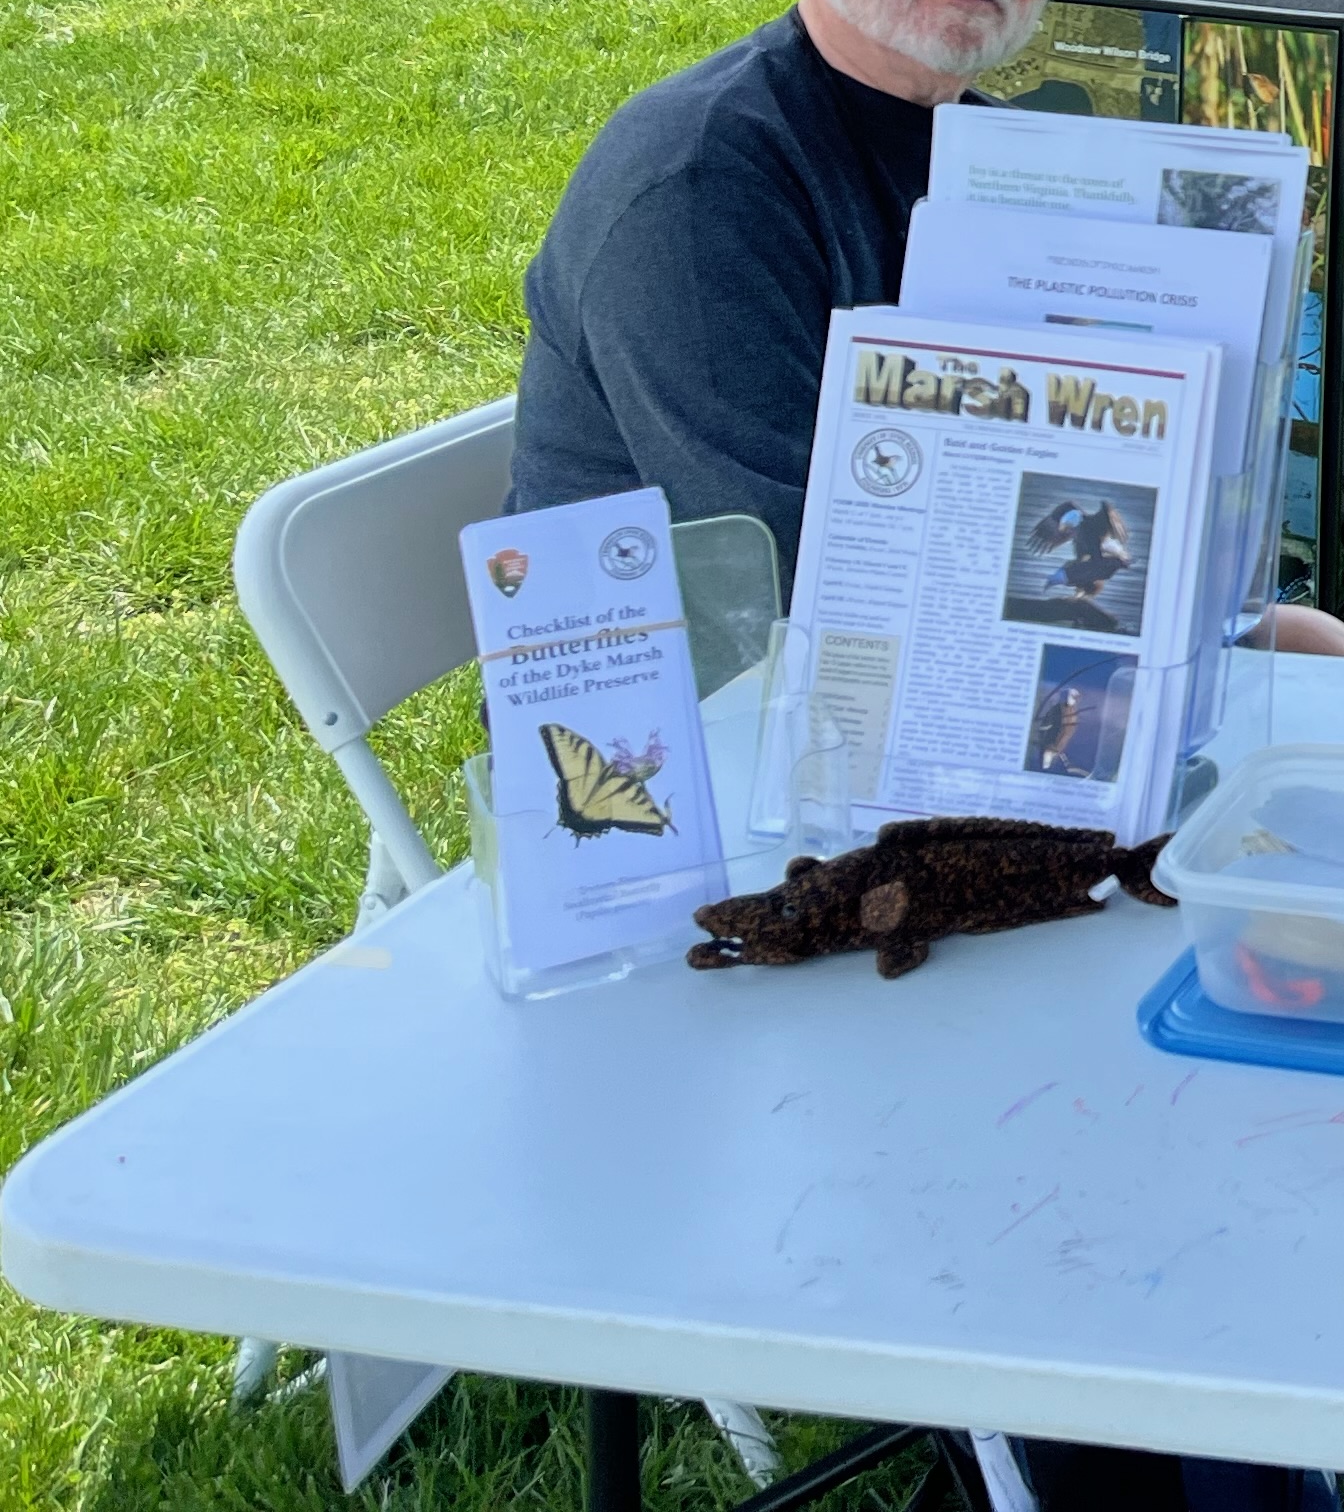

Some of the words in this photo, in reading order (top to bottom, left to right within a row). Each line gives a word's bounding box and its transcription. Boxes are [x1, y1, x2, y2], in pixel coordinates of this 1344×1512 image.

[1054, 40, 1101, 54] Woodrow
[1102, 45, 1137, 58] Wilson
[1137, 49, 1171, 63] Bridge
[1007, 276, 1033, 290] THE
[1035, 279, 1086, 296] PLASTIC
[1087, 285, 1158, 303] POLLUTION
[1160, 293, 1199, 307] CRISIS
[937, 353, 980, 375] The
[854, 349, 1031, 423] Marsh
[1046, 372, 1169, 439] Wren
[507, 615, 592, 639] Checklist
[596, 607, 614, 624] of
[619, 605, 647, 620] the
[510, 627, 649, 666] Butterflies
[826, 635, 889, 651] CONTENTS
[499, 673, 520, 688] of
[523, 669, 551, 684] the
[556, 659, 602, 681] Dyke
[606, 646, 665, 669] Marsh
[507, 683, 580, 707] Wildlife
[584, 670, 661, 694] Preserve
